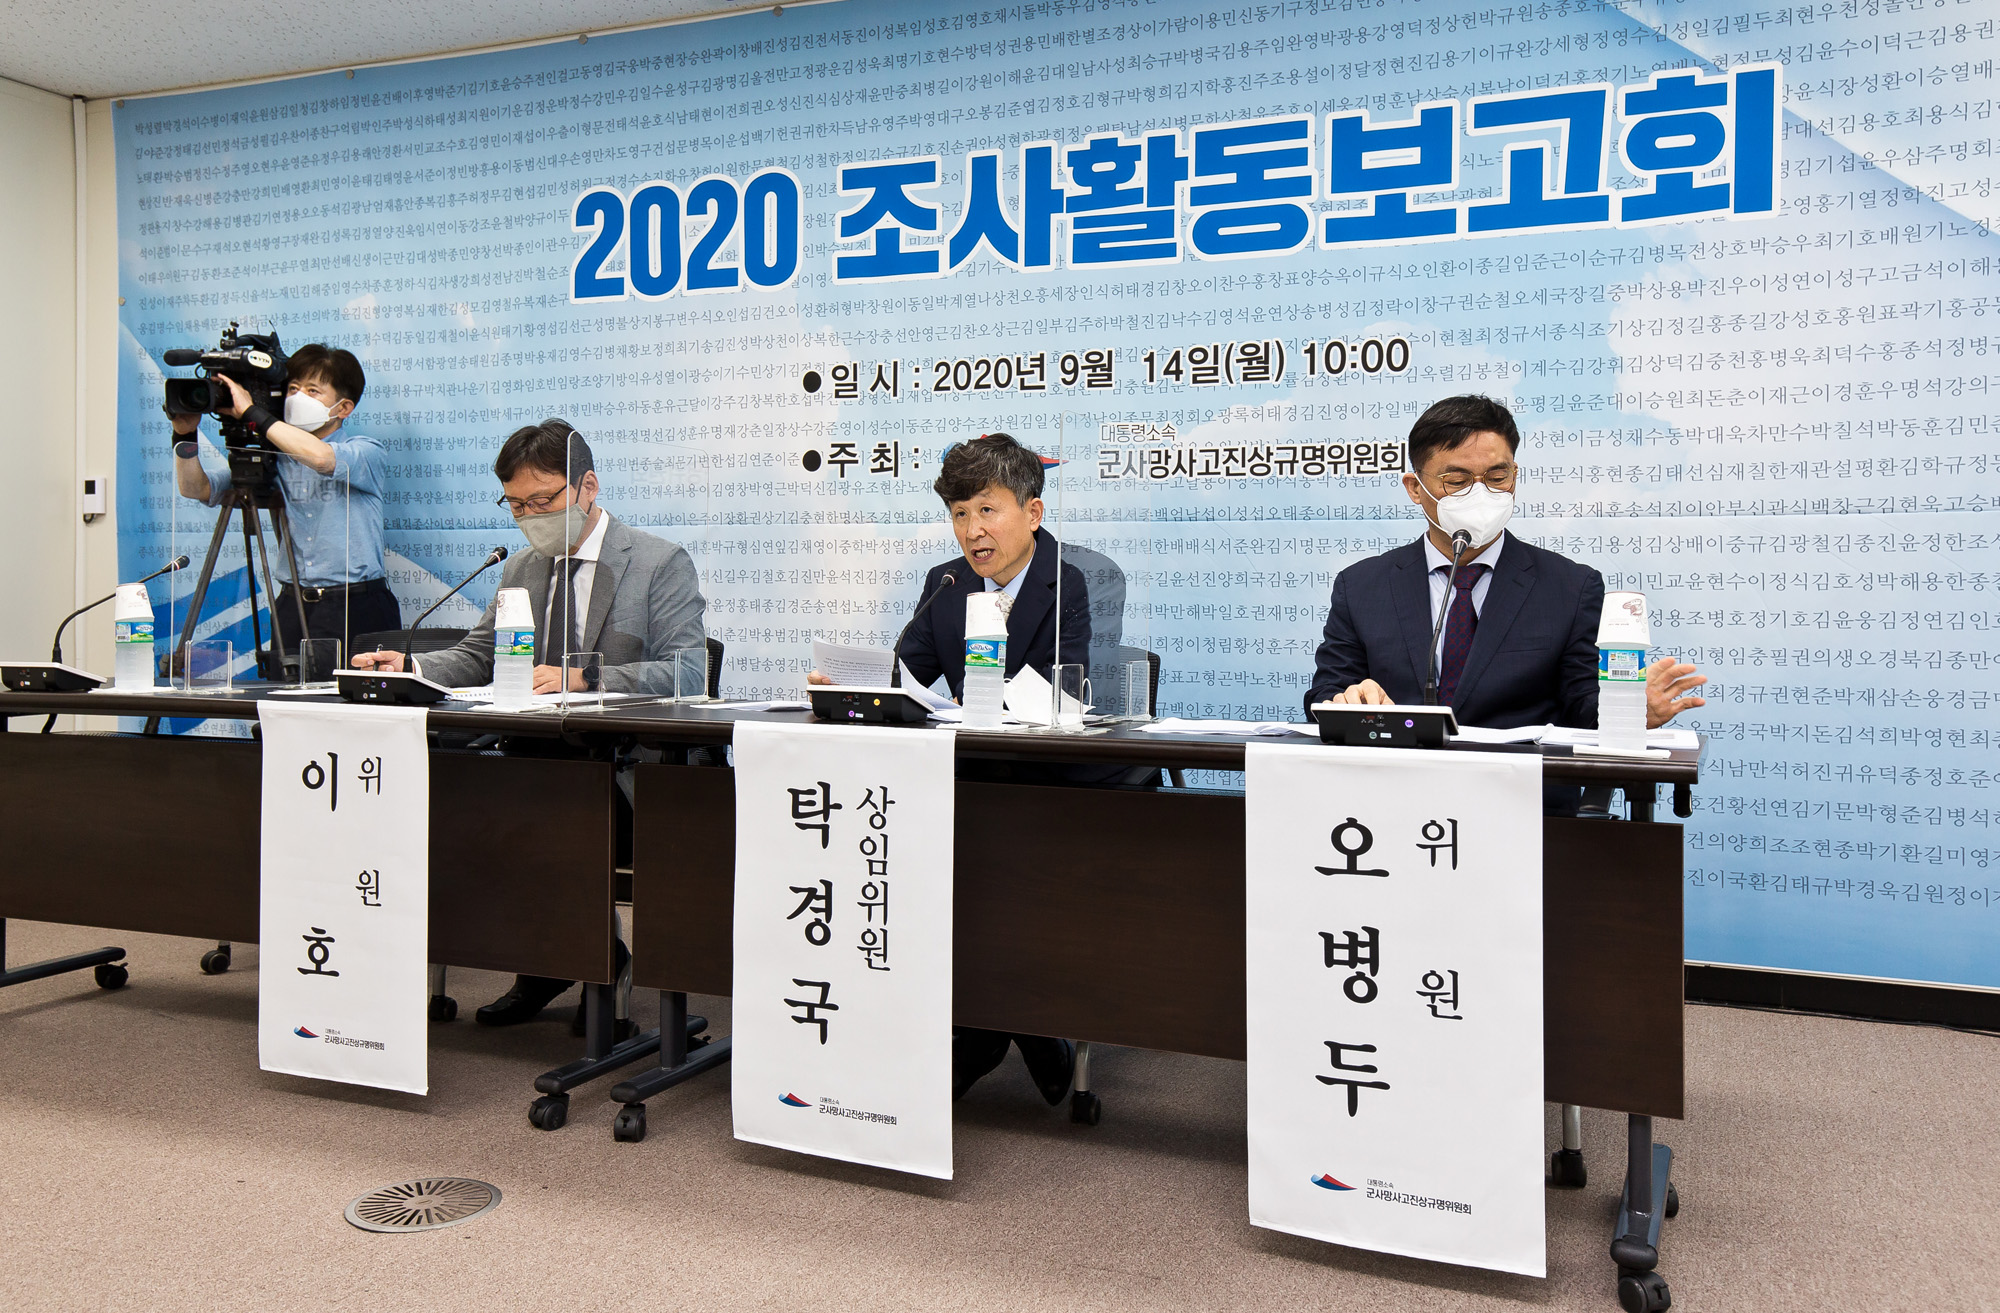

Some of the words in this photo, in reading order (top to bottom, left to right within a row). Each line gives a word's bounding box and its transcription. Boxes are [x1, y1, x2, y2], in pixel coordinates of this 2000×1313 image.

[572, 171, 797, 298] 2020
[837, 68, 1776, 280] 조사활동보고회
[833, 364, 860, 398] 일
[870, 362, 900, 396] 시
[931, 354, 1047, 393] 2020년
[1060, 349, 1115, 389] 9월
[1143, 339, 1288, 385] 14일(월)
[1303, 339, 1411, 376] 10:00
[827, 441, 857, 477] 주
[870, 441, 901, 478] 최
[1099, 442, 1407, 480] 군사망사고진상규명위원회
[856, 785, 896, 972] 상임위원
[783, 780, 843, 1046] 탁경국
[1314, 816, 1391, 1118] 오병두
[324, 1035, 385, 1052] 군사망사고진상규명위원회
[818, 1104, 898, 1127] 군사망사고진상규명위원회
[1366, 1178, 1394, 1189] 대통령소속
[1366, 1187, 1472, 1216] 군사망사고진상규명위원회
